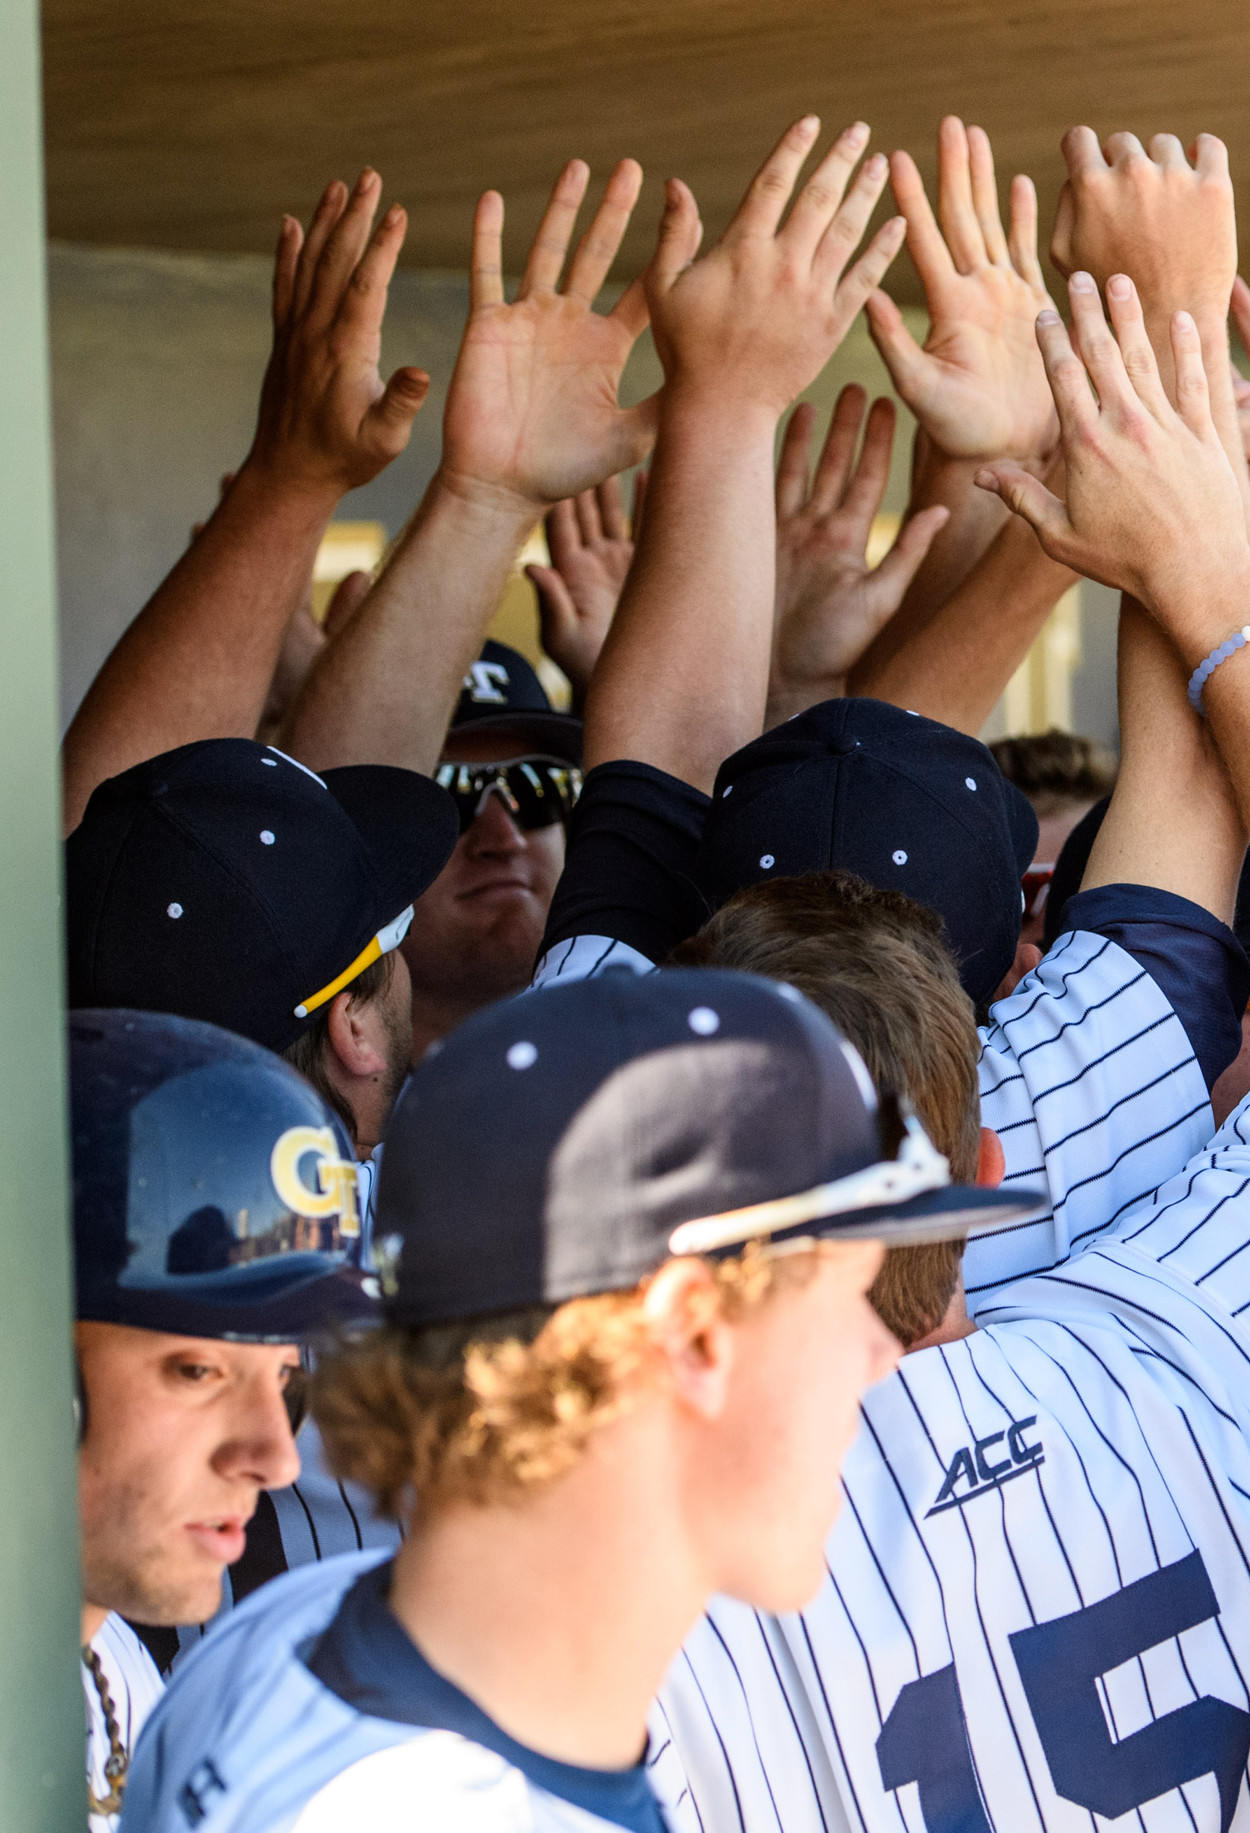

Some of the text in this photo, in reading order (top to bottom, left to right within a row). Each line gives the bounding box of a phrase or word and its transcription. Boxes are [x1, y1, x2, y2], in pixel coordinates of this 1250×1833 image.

[463, 660, 510, 705] T
[270, 1126, 360, 1238] GT
[928, 1414, 1045, 1512] ACC
